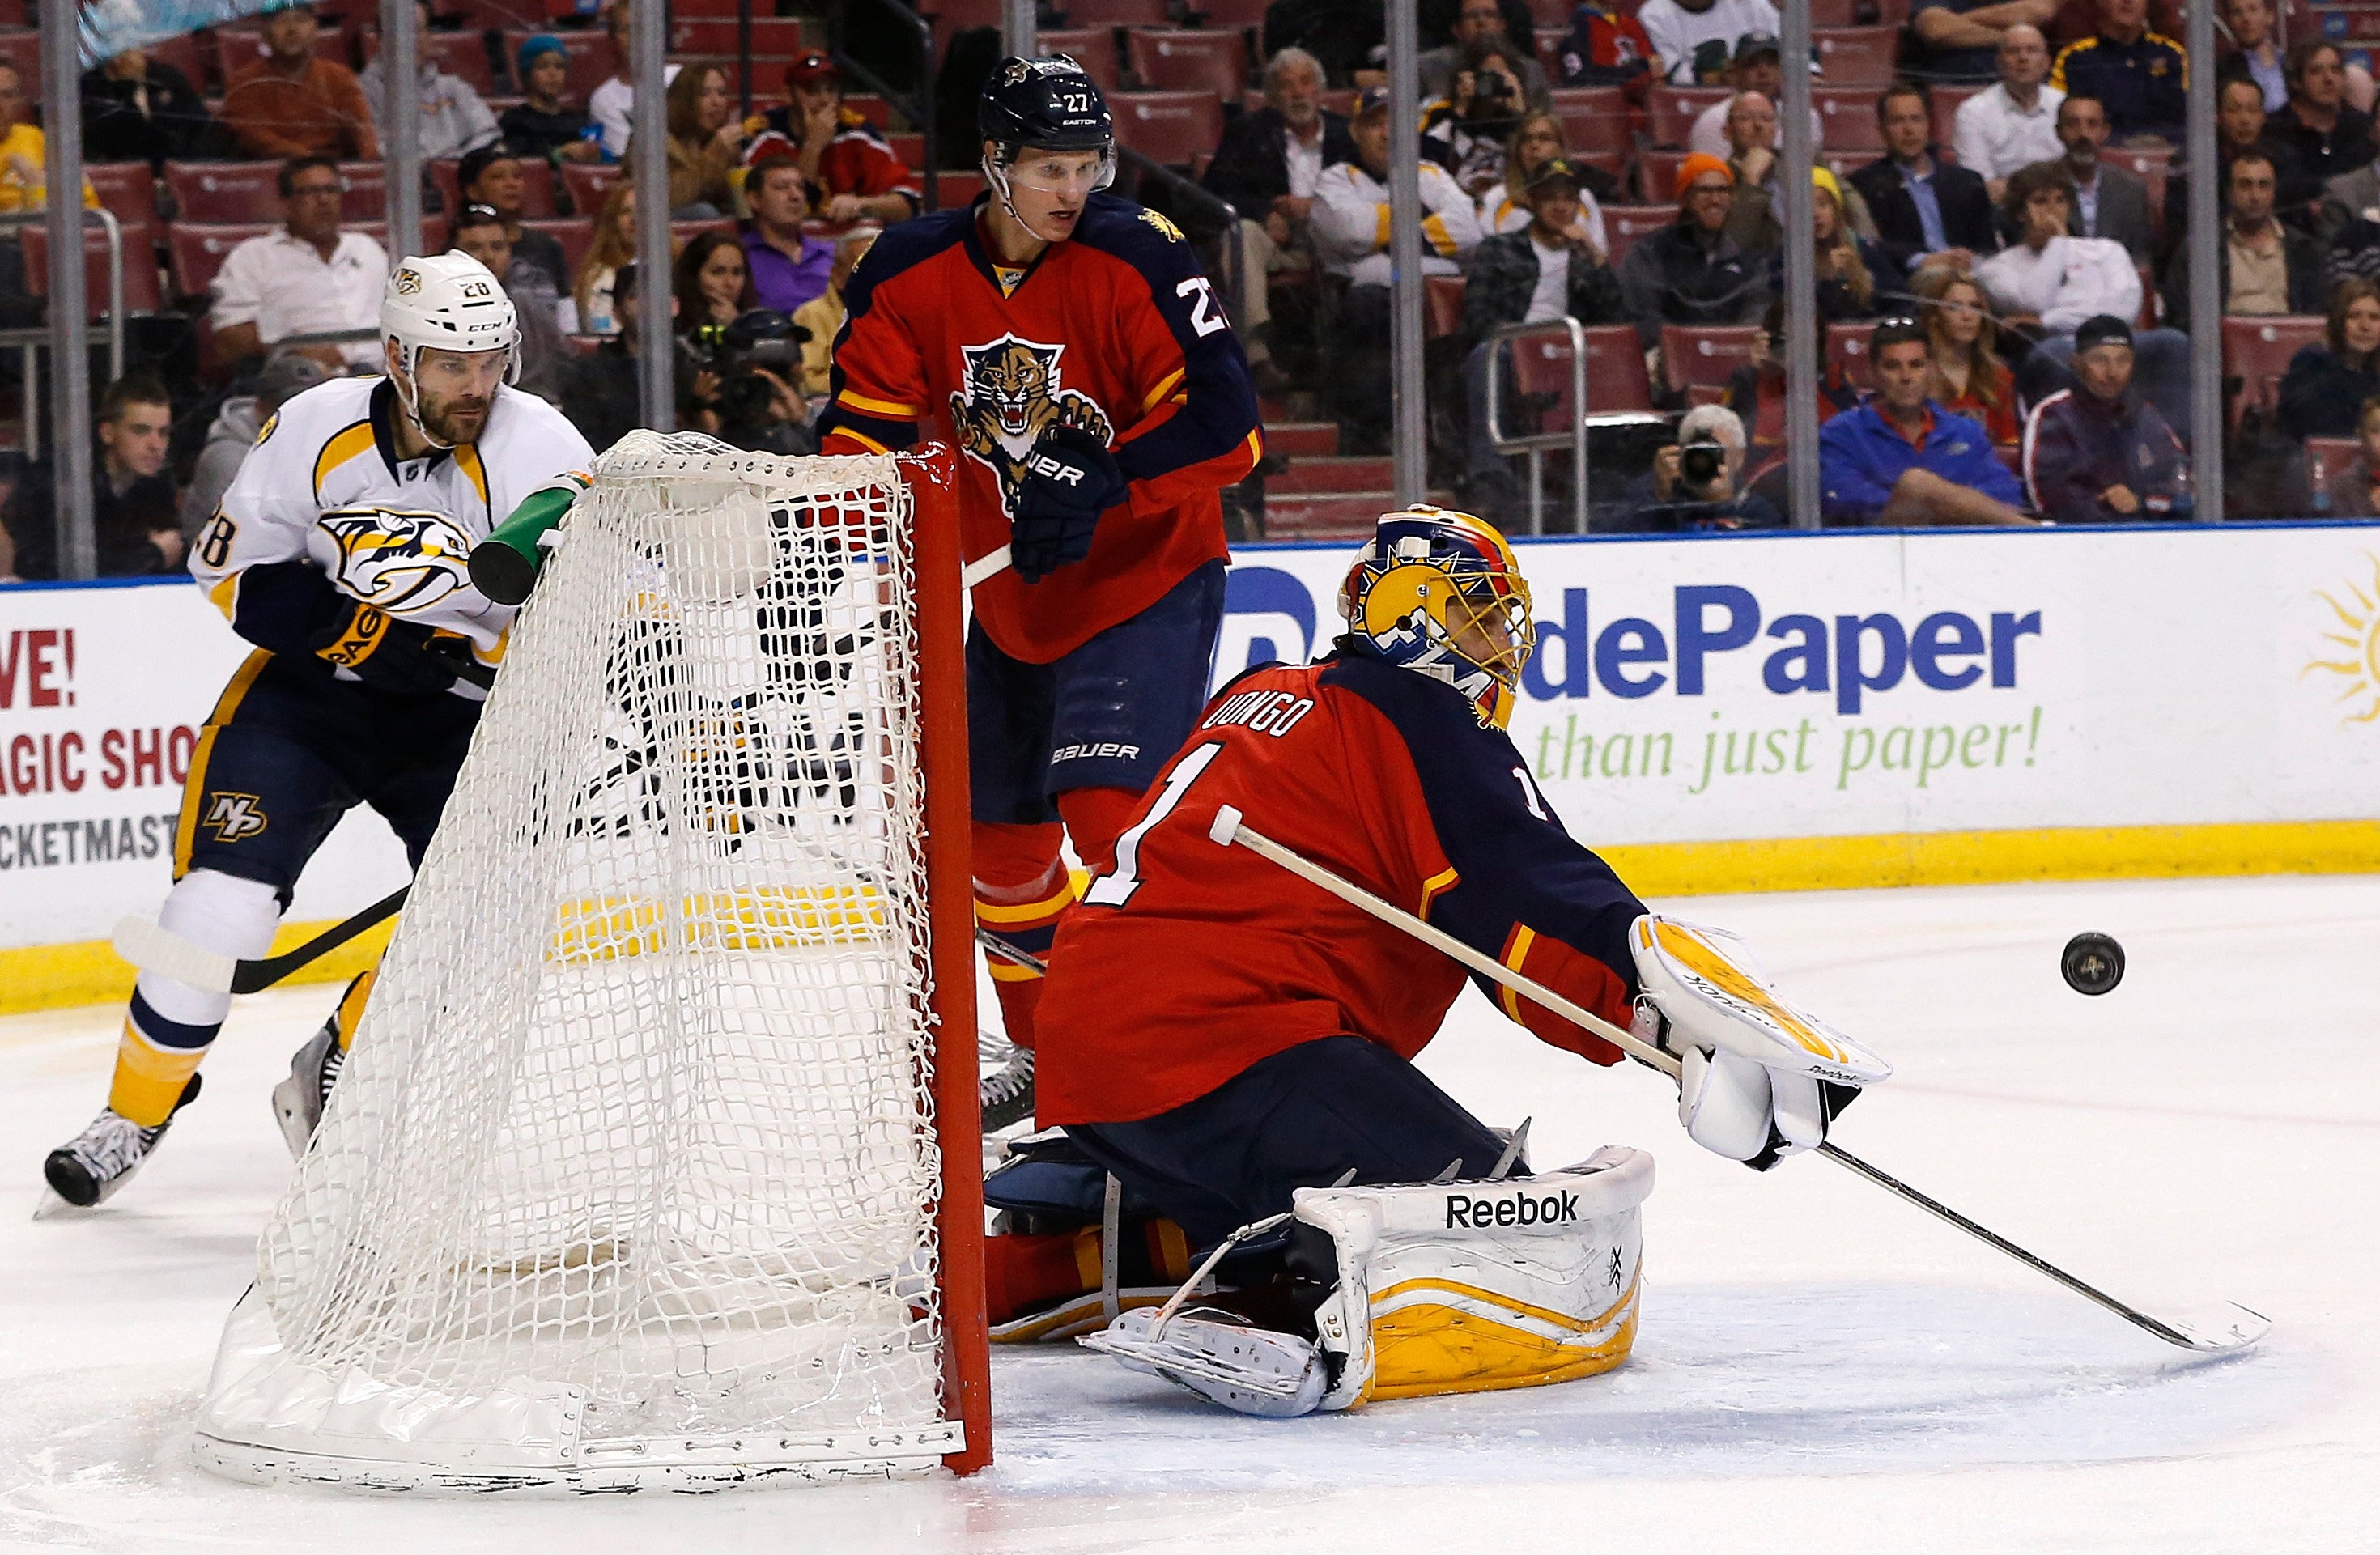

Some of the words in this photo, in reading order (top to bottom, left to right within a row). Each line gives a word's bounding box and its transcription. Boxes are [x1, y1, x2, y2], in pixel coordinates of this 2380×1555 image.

[1062, 93, 1090, 113] 27
[459, 281, 492, 299] 28
[1175, 276, 1231, 338] 2
[467, 321, 503, 333] CCM
[195, 504, 240, 570] 8
[0, 730, 85, 797] GIC
[1051, 742, 1141, 766] BAUER
[1535, 712, 1674, 780] than
[1687, 710, 1819, 796] just
[1835, 705, 2043, 791] paper!
[1511, 767, 1549, 822] 1
[1081, 740, 1226, 908] 1
[1446, 1189, 1579, 1229] Reebok
